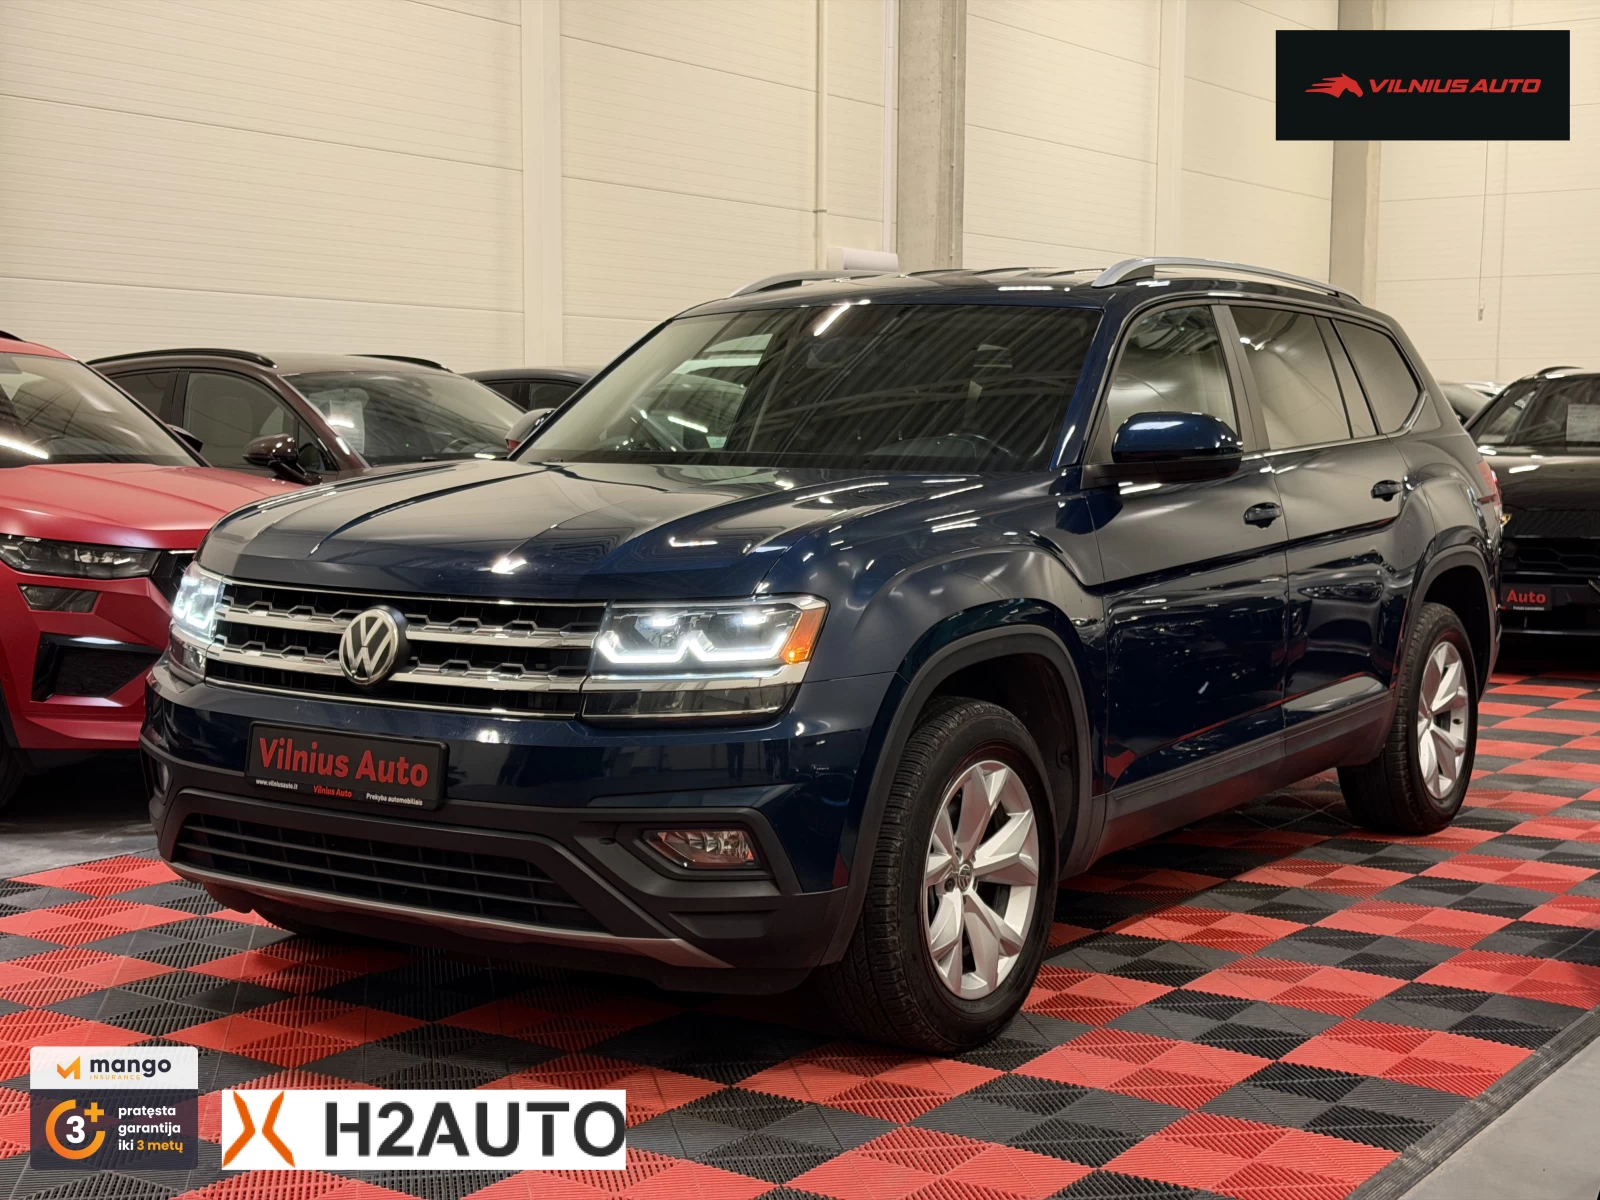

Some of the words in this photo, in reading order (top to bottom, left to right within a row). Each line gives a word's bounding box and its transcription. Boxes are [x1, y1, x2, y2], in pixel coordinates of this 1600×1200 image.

[1506, 589, 1546, 604] Auto
[259, 737, 349, 778] Vilnius
[355, 750, 428, 787] Auto
[313, 784, 335, 796] Vilnius
[335, 788, 353, 798] Auto
[365, 792, 387, 802] Prekyba
